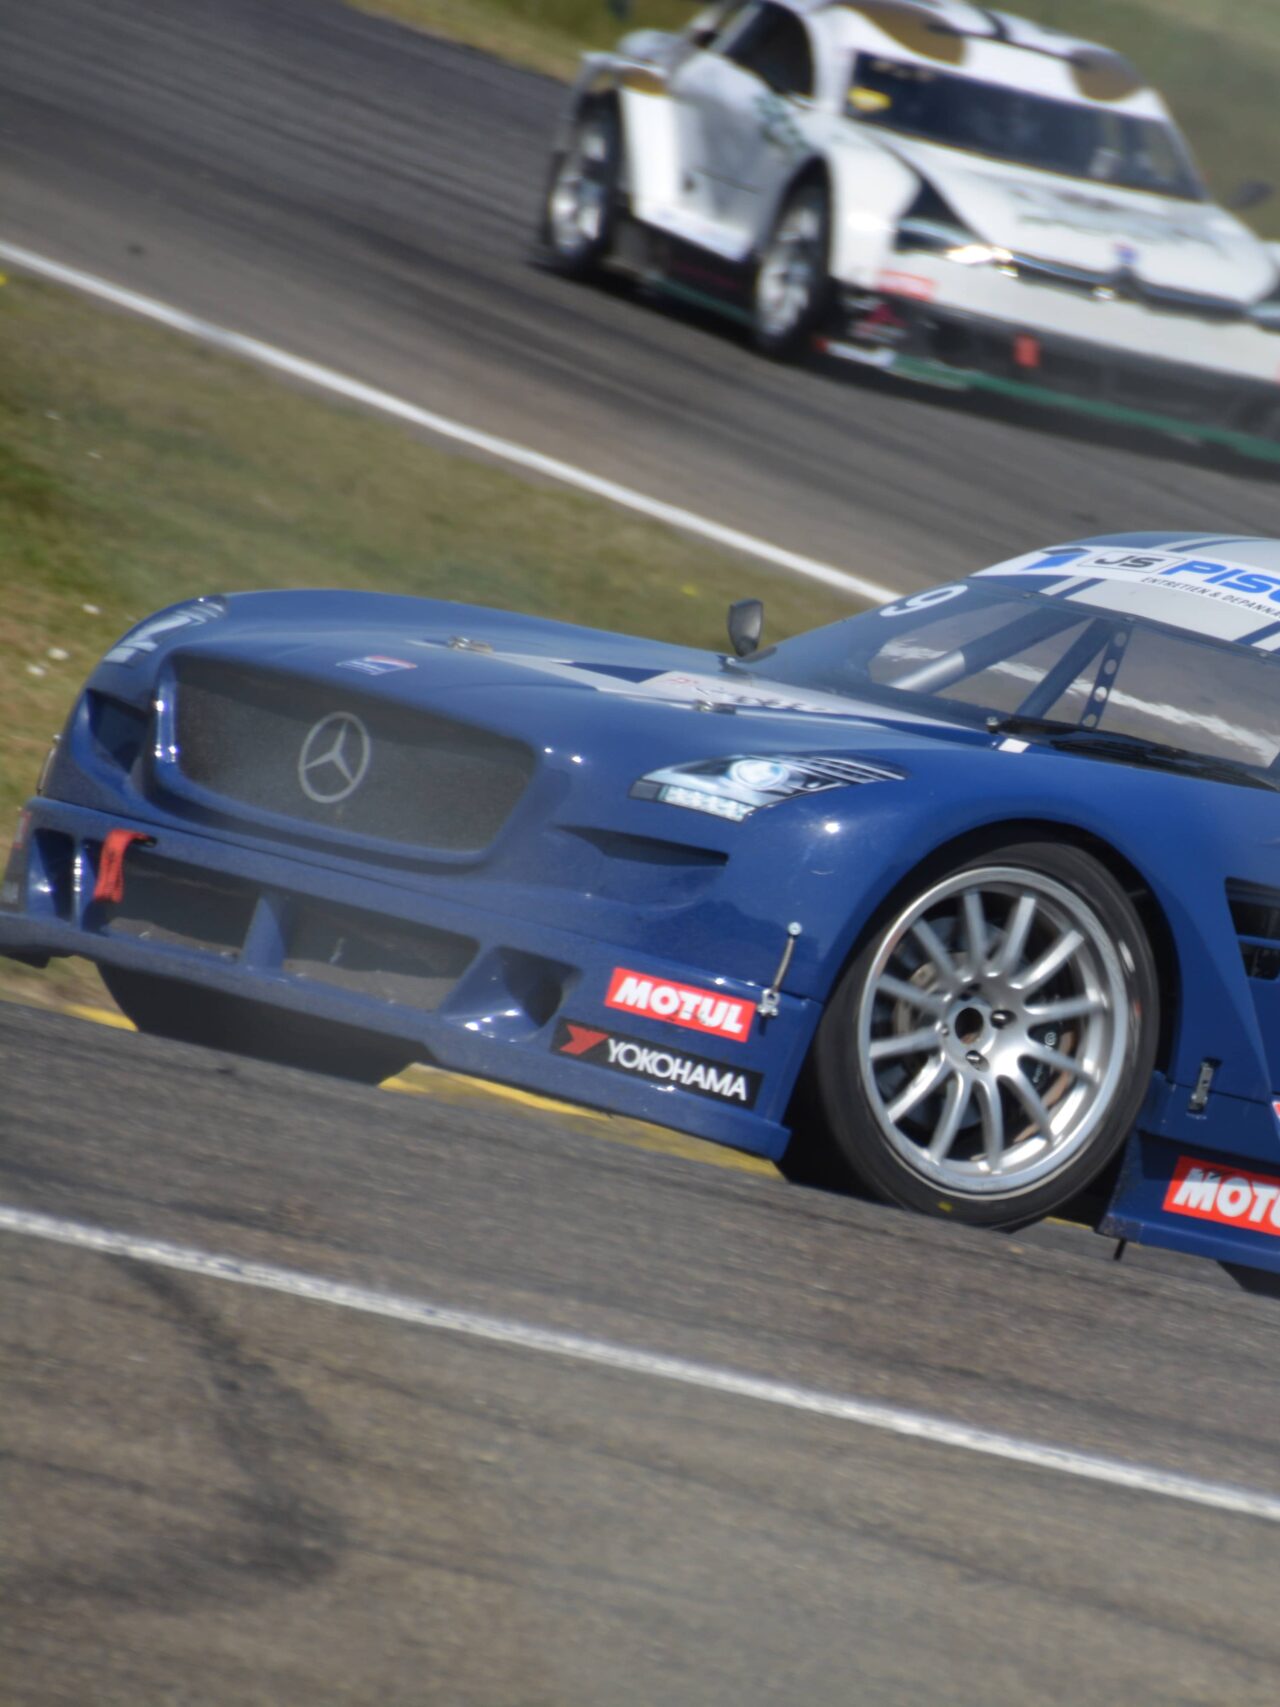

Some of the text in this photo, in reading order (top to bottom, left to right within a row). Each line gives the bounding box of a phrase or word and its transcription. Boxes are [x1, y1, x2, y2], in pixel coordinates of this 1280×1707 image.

[1094, 555, 1165, 569] JS
[879, 584, 968, 617] 9
[1140, 576, 1210, 595] ENTRETIEN
[612, 976, 743, 1033] MOTUL
[607, 1038, 747, 1101] YOKOHAMA
